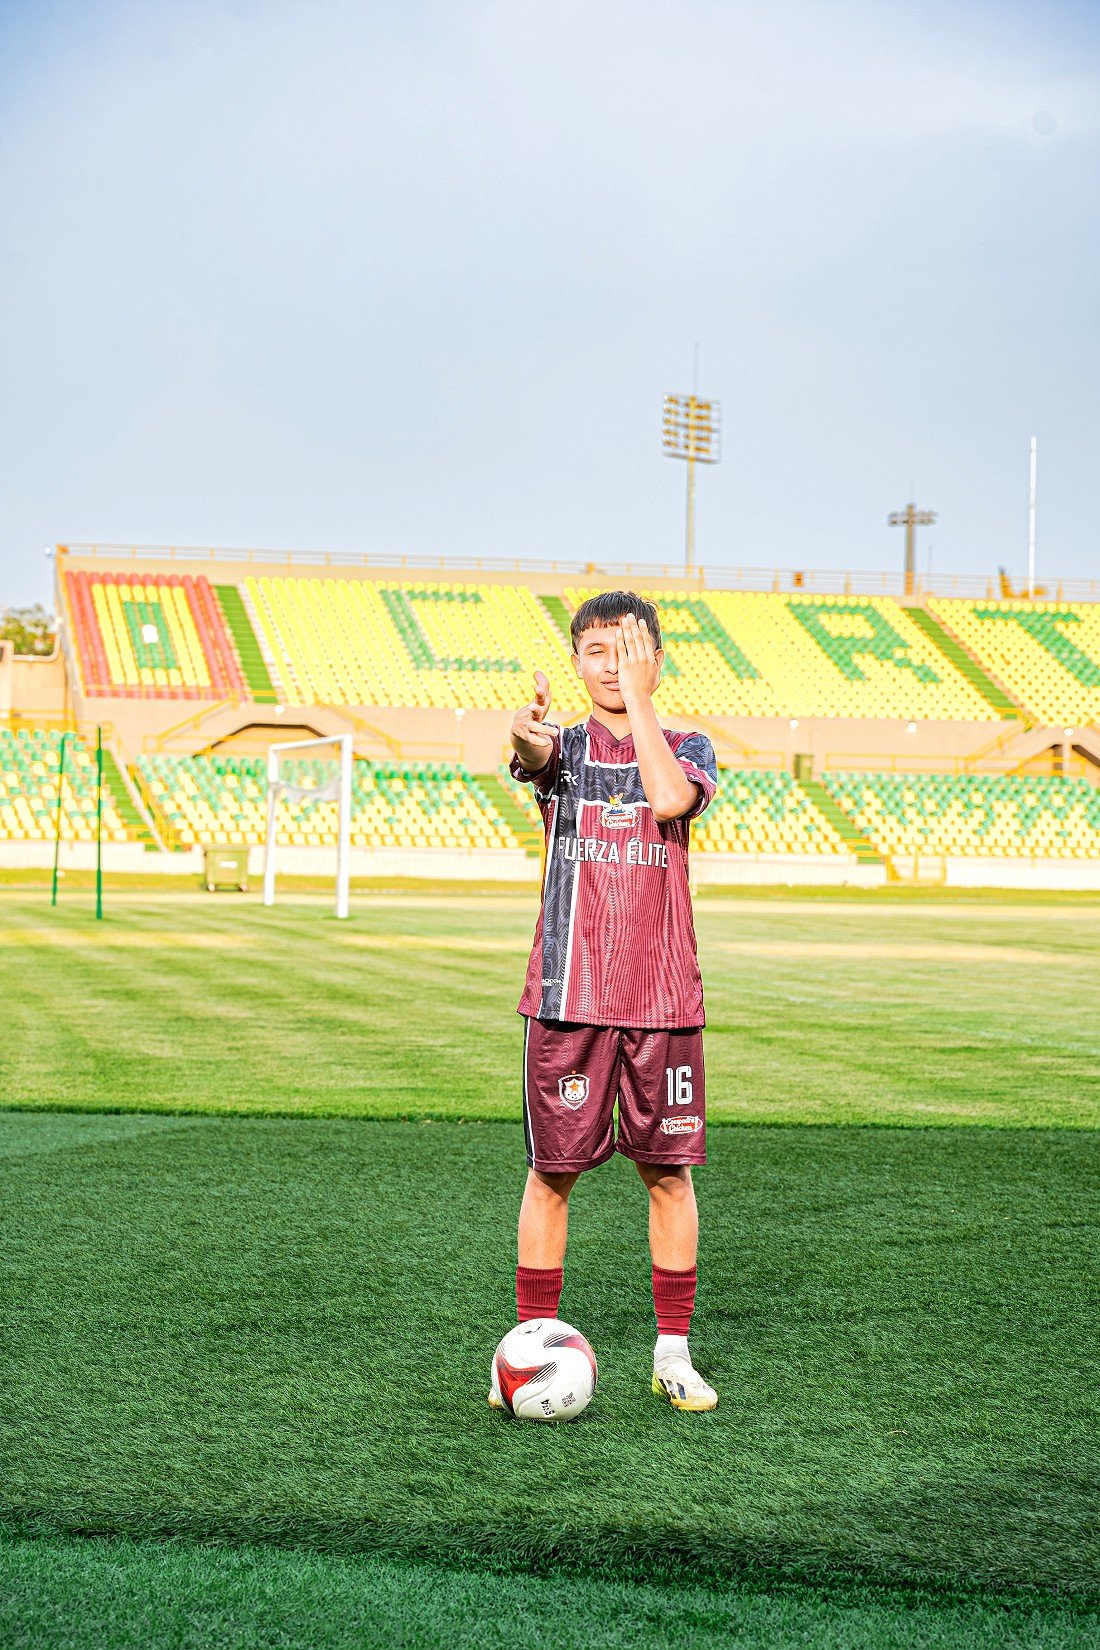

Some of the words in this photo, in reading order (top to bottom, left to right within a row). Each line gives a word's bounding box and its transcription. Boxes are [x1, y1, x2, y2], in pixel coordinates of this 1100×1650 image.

[558, 836, 620, 864] FUERZA
[626, 836, 668, 868] ÉLITE
[666, 1065, 693, 1106] 16
